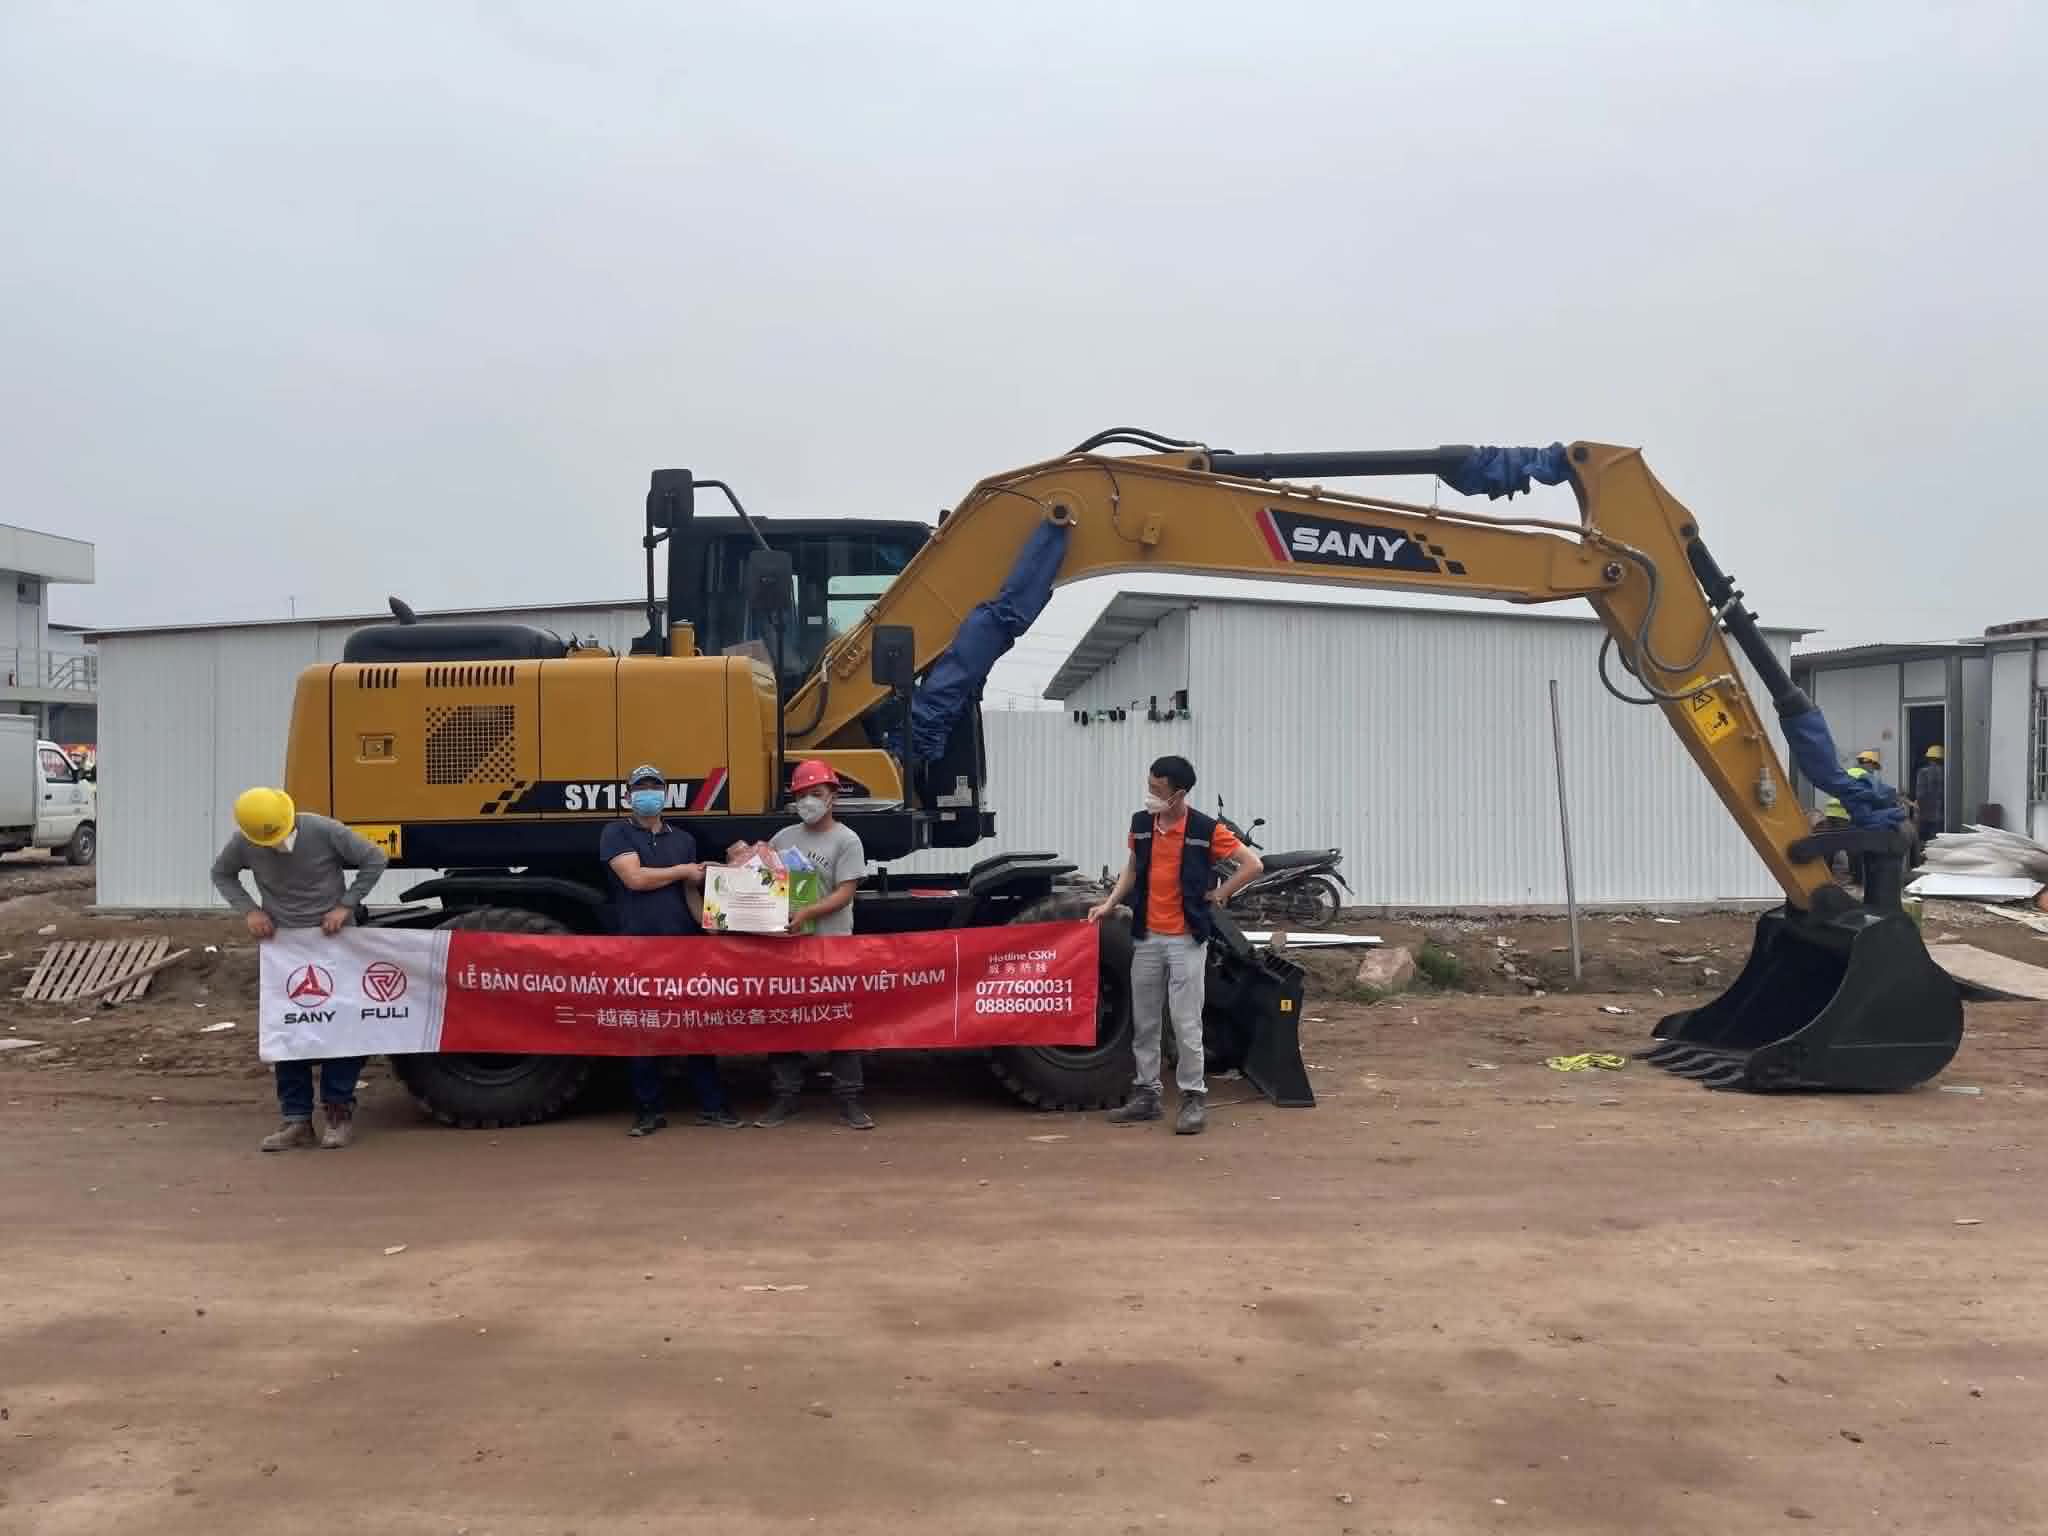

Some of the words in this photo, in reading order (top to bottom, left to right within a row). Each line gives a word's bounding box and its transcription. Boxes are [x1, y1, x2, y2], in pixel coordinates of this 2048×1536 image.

[1292, 527, 1407, 561] SANY
[565, 783, 688, 810] SY15W
[989, 952, 1026, 963] Hotline
[1028, 950, 1056, 960] CSKH
[481, 968, 519, 991] BÀN
[523, 974, 567, 992] GIAO
[571, 971, 608, 994] MÁY
[613, 972, 650, 996] XÚC
[654, 977, 682, 1000] TẠI
[686, 972, 738, 996] CÔNG
[742, 977, 765, 996] TY
[769, 976, 806, 996] FULI
[810, 975, 858, 993] SANY
[862, 969, 899, 993] VIỆT
[903, 968, 945, 986] NAM
[976, 979, 1072, 995] 0777600031
[976, 997, 1072, 1013] 0888600031
[284, 1010, 336, 1024] SANY
[361, 1007, 409, 1020] FULI
